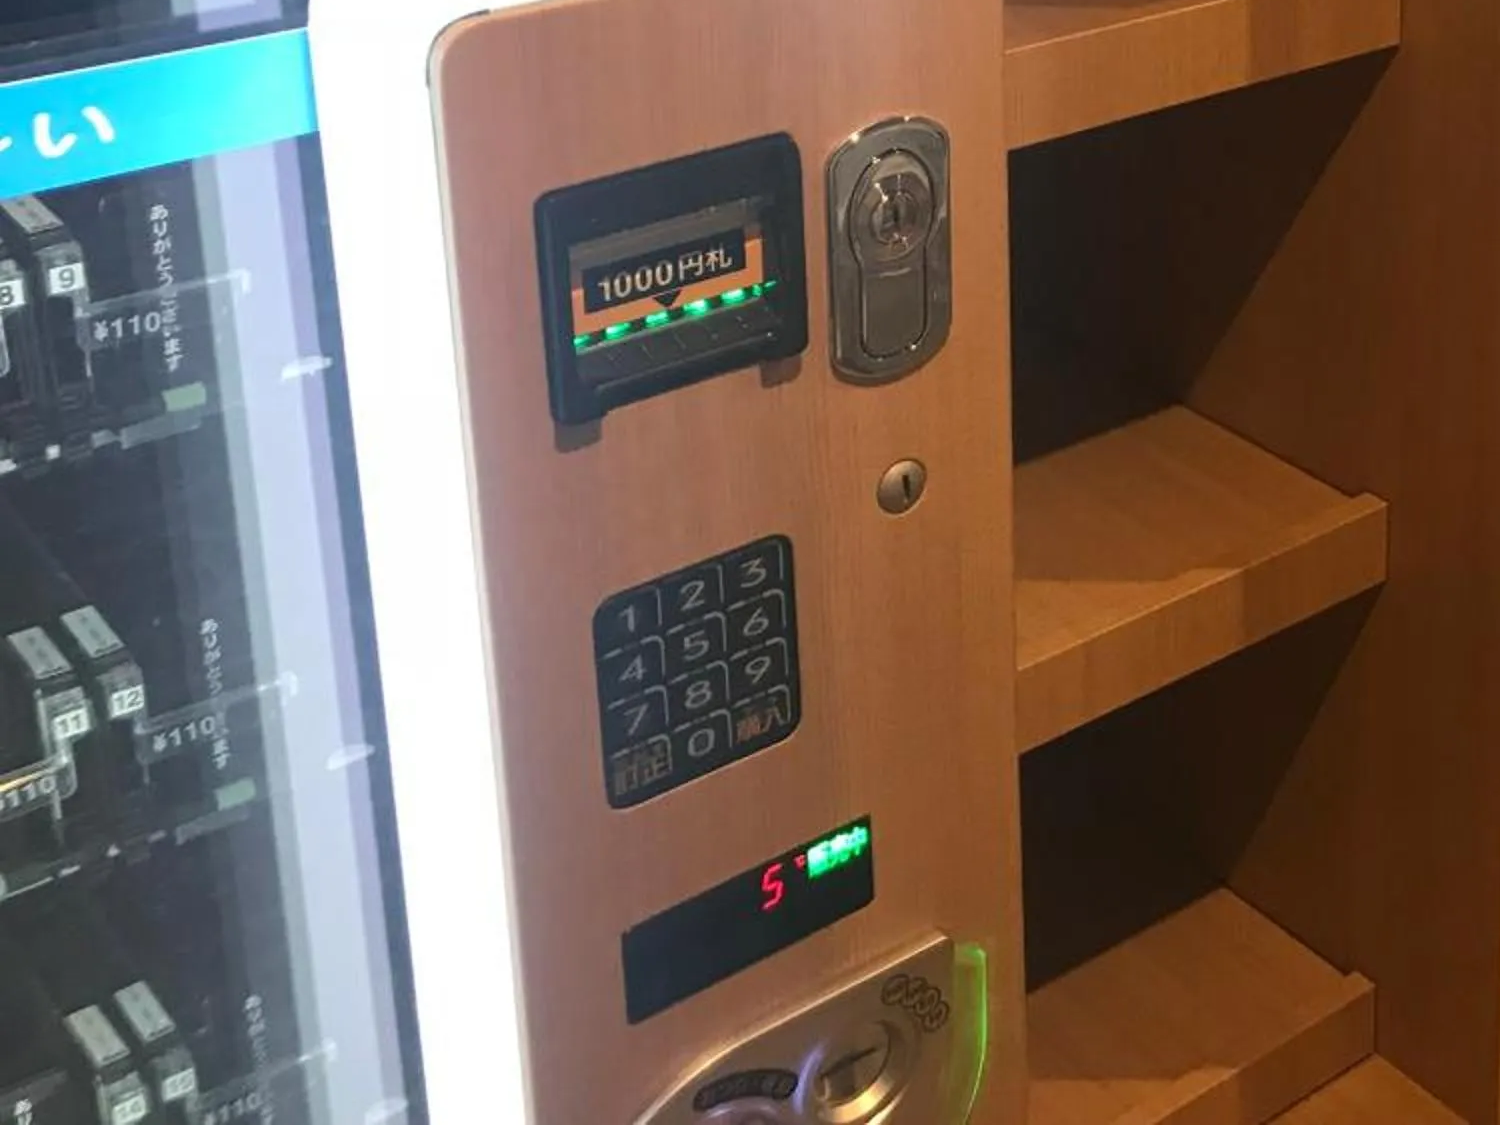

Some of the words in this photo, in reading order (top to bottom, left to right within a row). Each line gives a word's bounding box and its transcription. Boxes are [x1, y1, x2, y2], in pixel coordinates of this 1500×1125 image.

[58, 267, 75, 289] 9
[597, 245, 734, 302] 1000円札
[93, 311, 161, 342] ¥110
[740, 557, 768, 590] 3
[681, 579, 706, 611] 2
[618, 604, 637, 633] 1
[743, 605, 770, 636] 6
[684, 631, 709, 661] 5
[620, 655, 647, 683] 4
[744, 655, 771, 683] 9
[114, 690, 143, 710] 12
[684, 680, 712, 709] 8
[57, 713, 82, 736] 11
[152, 716, 216, 753] ¥110
[623, 703, 649, 736] 7
[687, 727, 715, 757] 0
